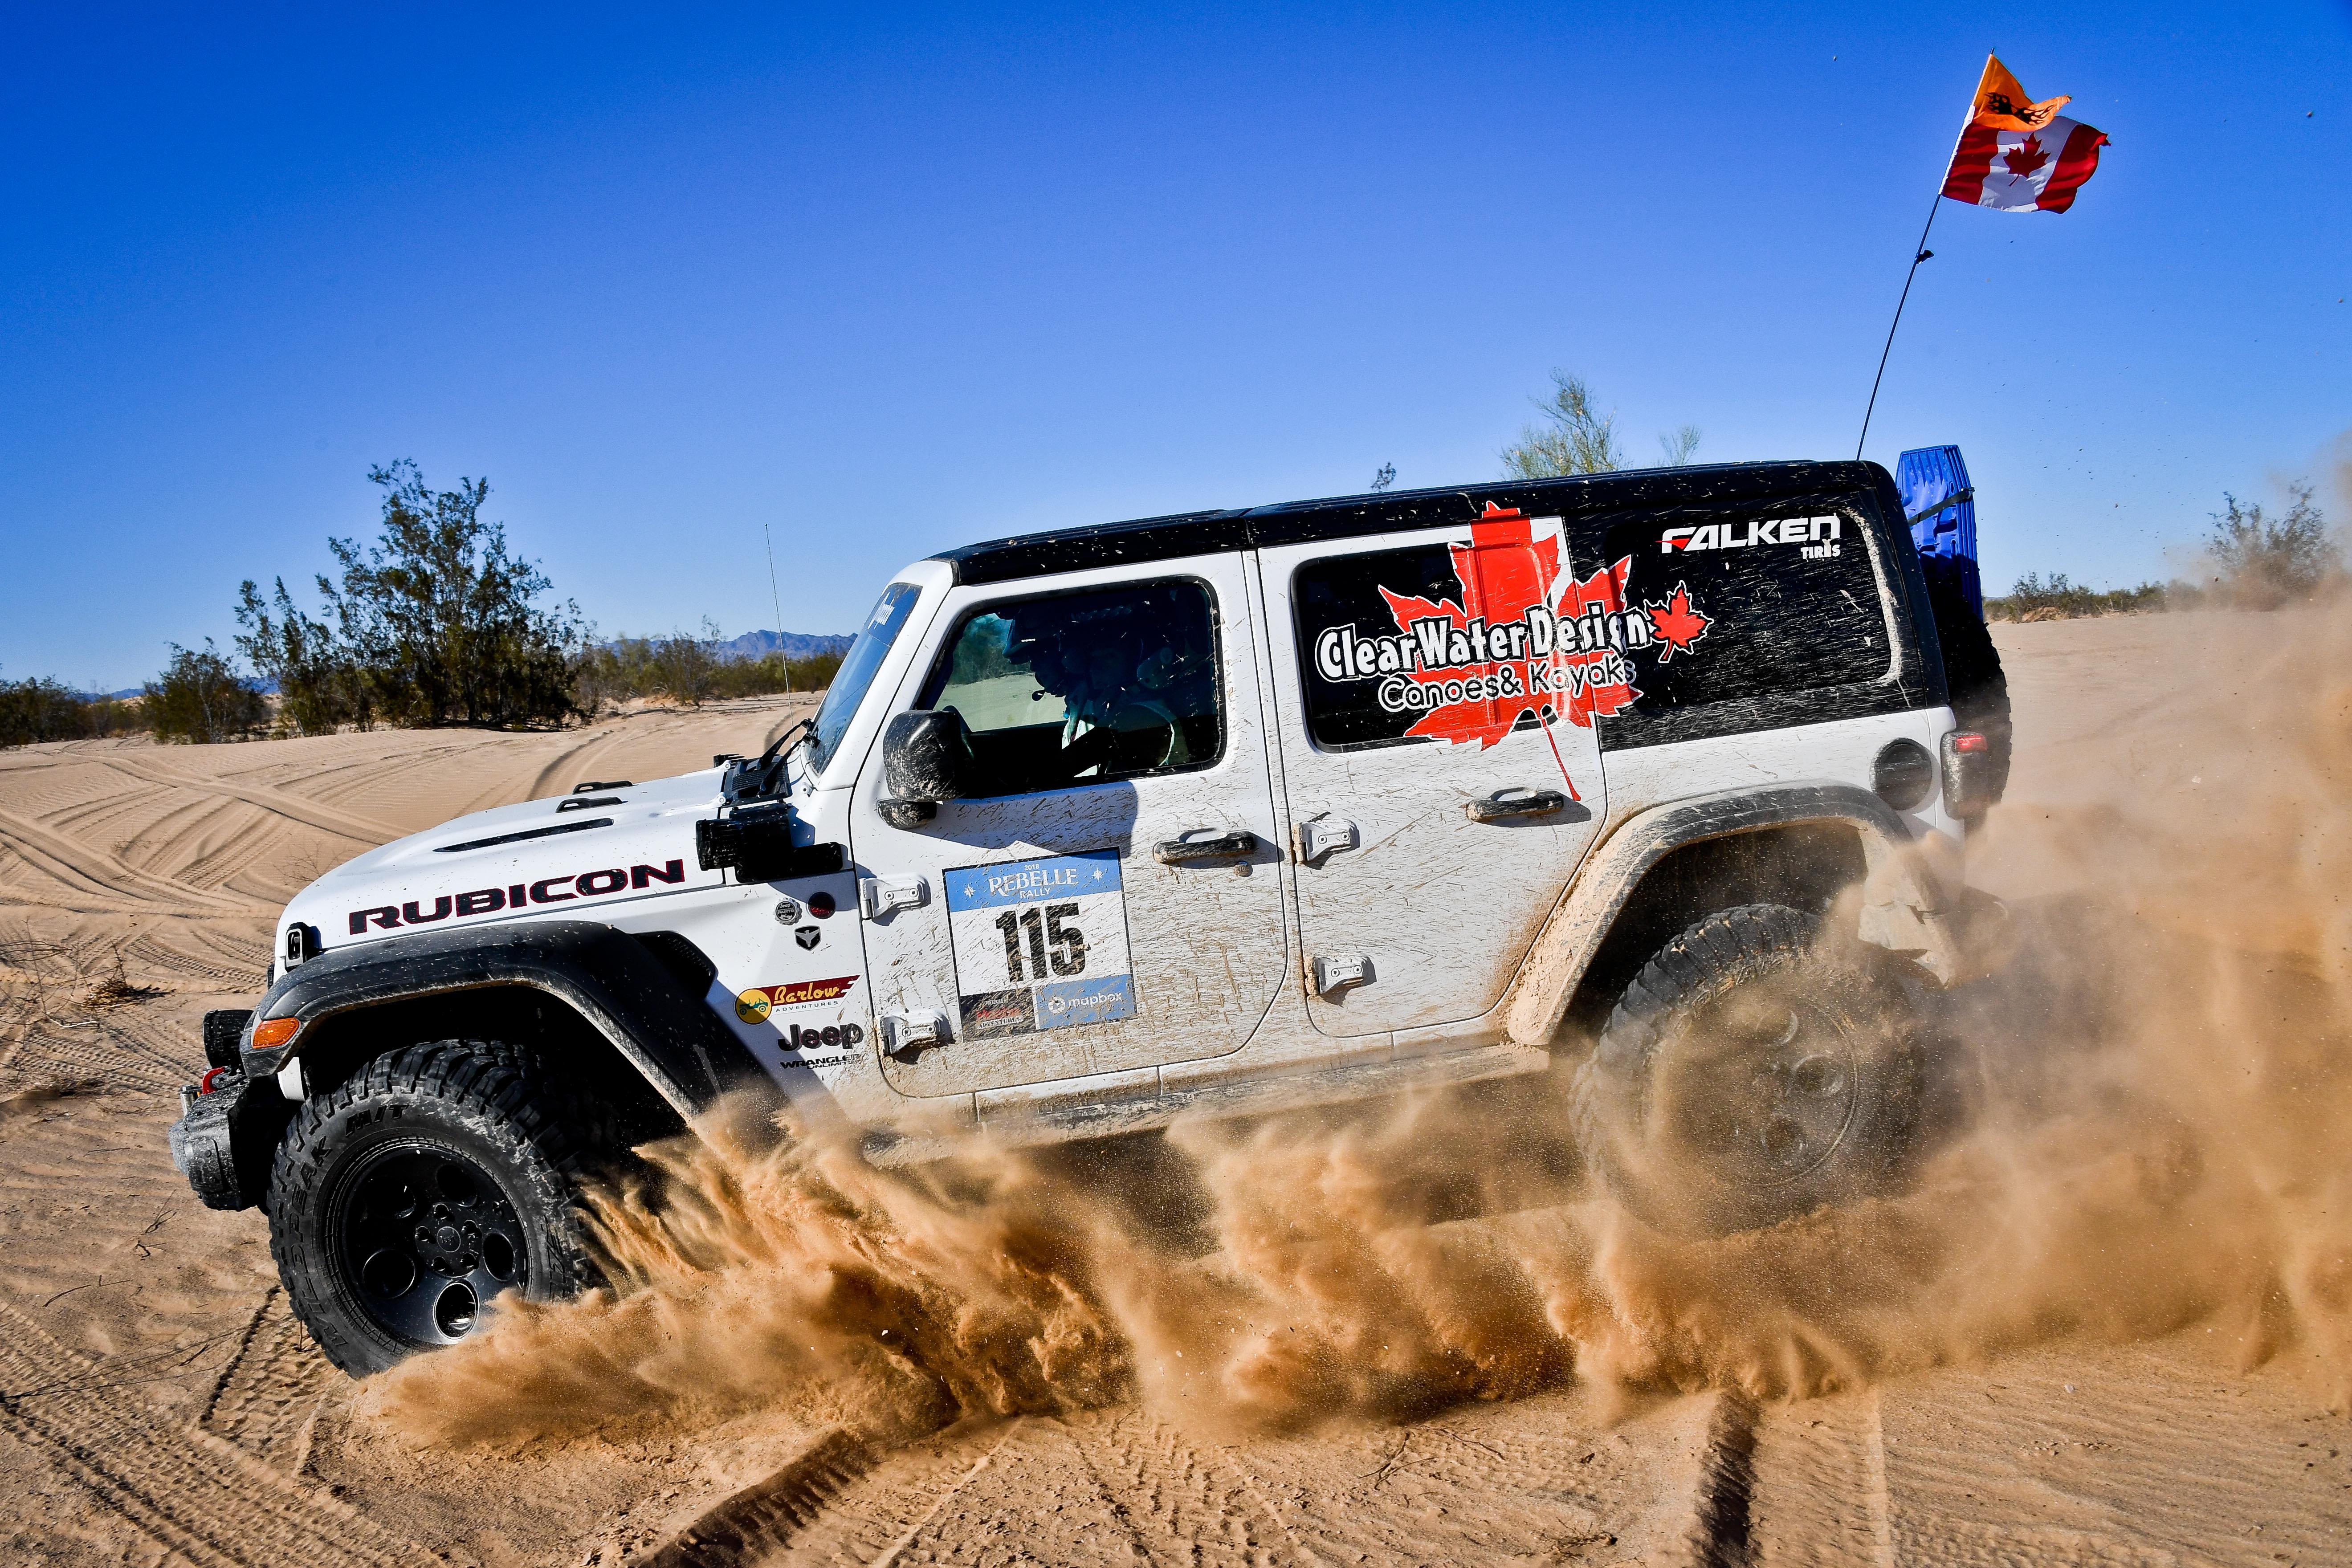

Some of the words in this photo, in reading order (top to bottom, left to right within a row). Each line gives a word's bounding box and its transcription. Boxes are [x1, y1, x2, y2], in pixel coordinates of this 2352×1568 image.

[1656, 515, 1840, 554] FALKEN
[1529, 652, 1637, 699] Kayaks
[350, 859, 685, 935] RUBICON
[988, 868, 1079, 897] REBELLE
[1019, 887, 1051, 899] RALLY
[995, 902, 1086, 982] 115
[774, 982, 840, 1005] Barlow
[776, 1000, 838, 1012] ADVENTURES
[1068, 992, 1123, 1008] mapbox
[777, 1023, 864, 1051] Jeep
[807, 1060, 857, 1069] UNLIMIT
[345, 1104, 409, 1137] M/T
[289, 1136, 348, 1345] WILDPEAK
